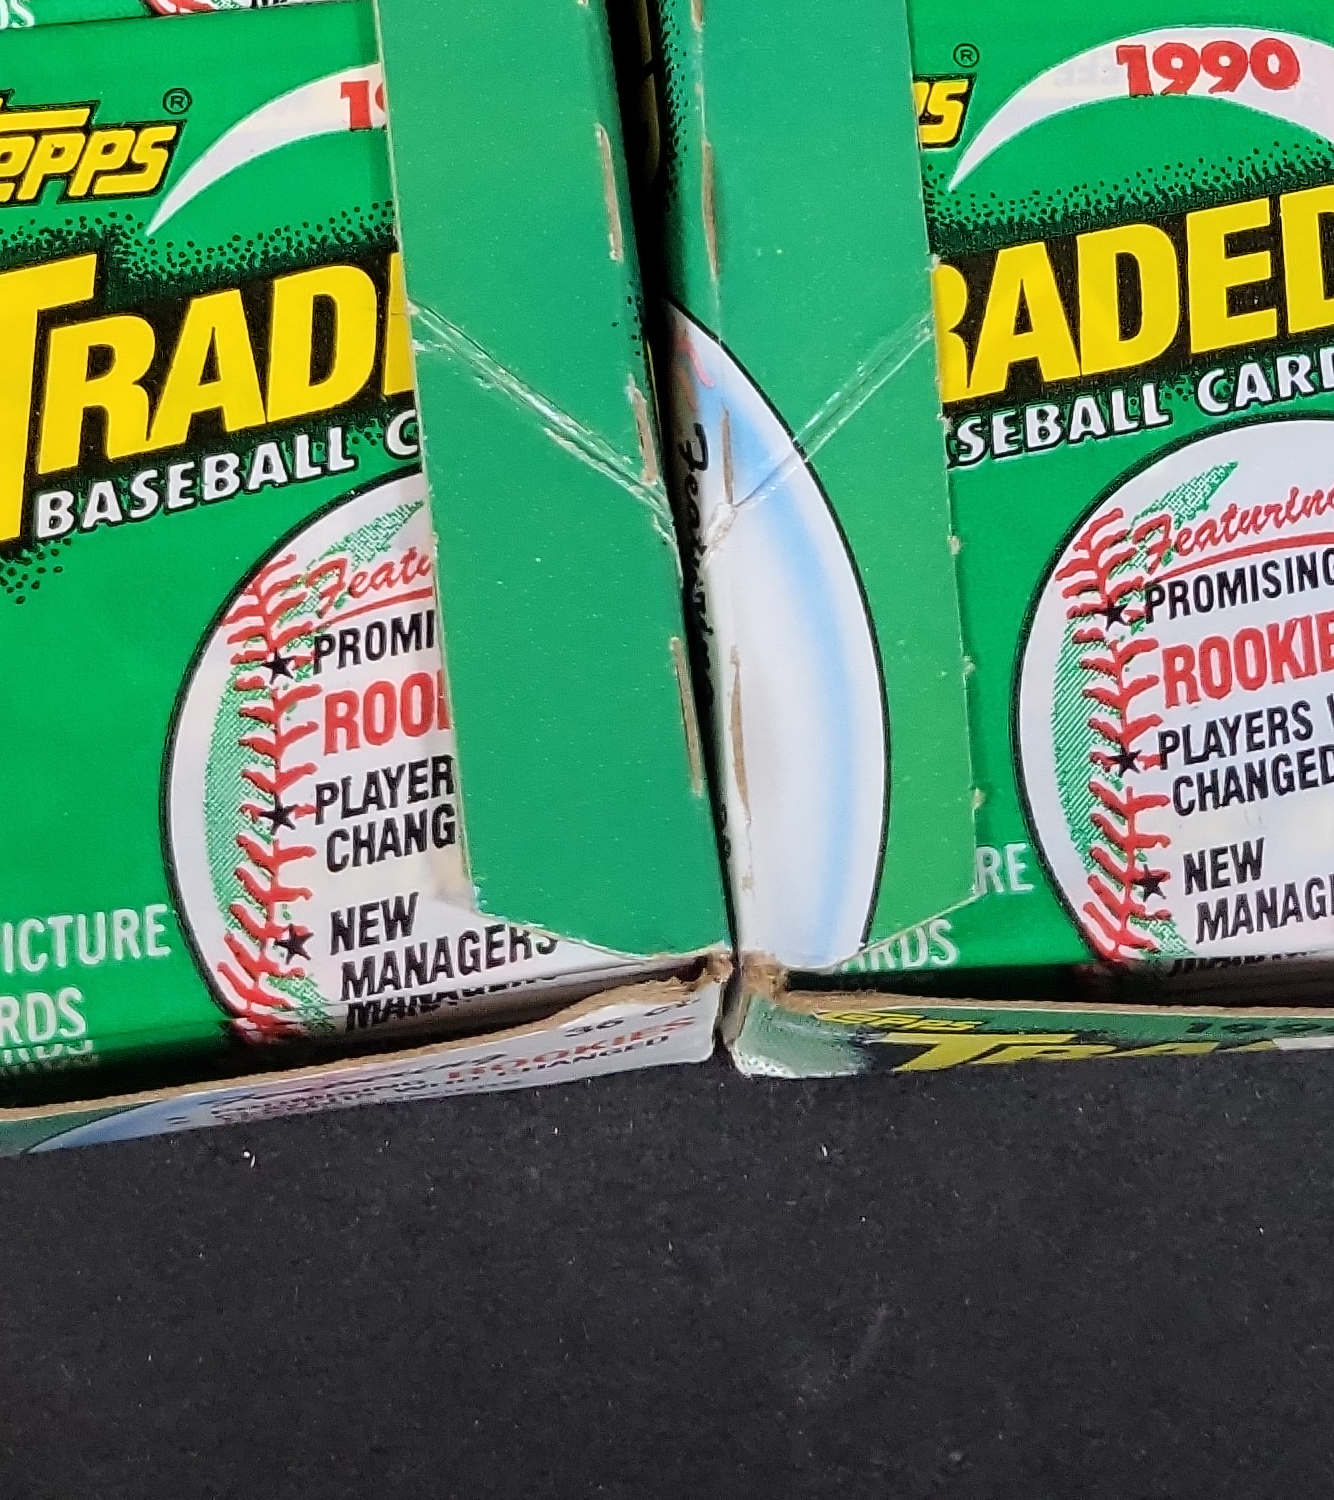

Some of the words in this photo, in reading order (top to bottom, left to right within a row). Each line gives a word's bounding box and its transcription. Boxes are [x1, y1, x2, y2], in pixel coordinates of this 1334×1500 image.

[1116, 37, 1301, 98] 1990
[950, 386, 1170, 465] SEBALL
[36, 428, 355, 540] BASEBALL
[1158, 700, 1314, 770] PLAYERS
[1183, 838, 1265, 895] NEW
[330, 891, 419, 955] NEW
